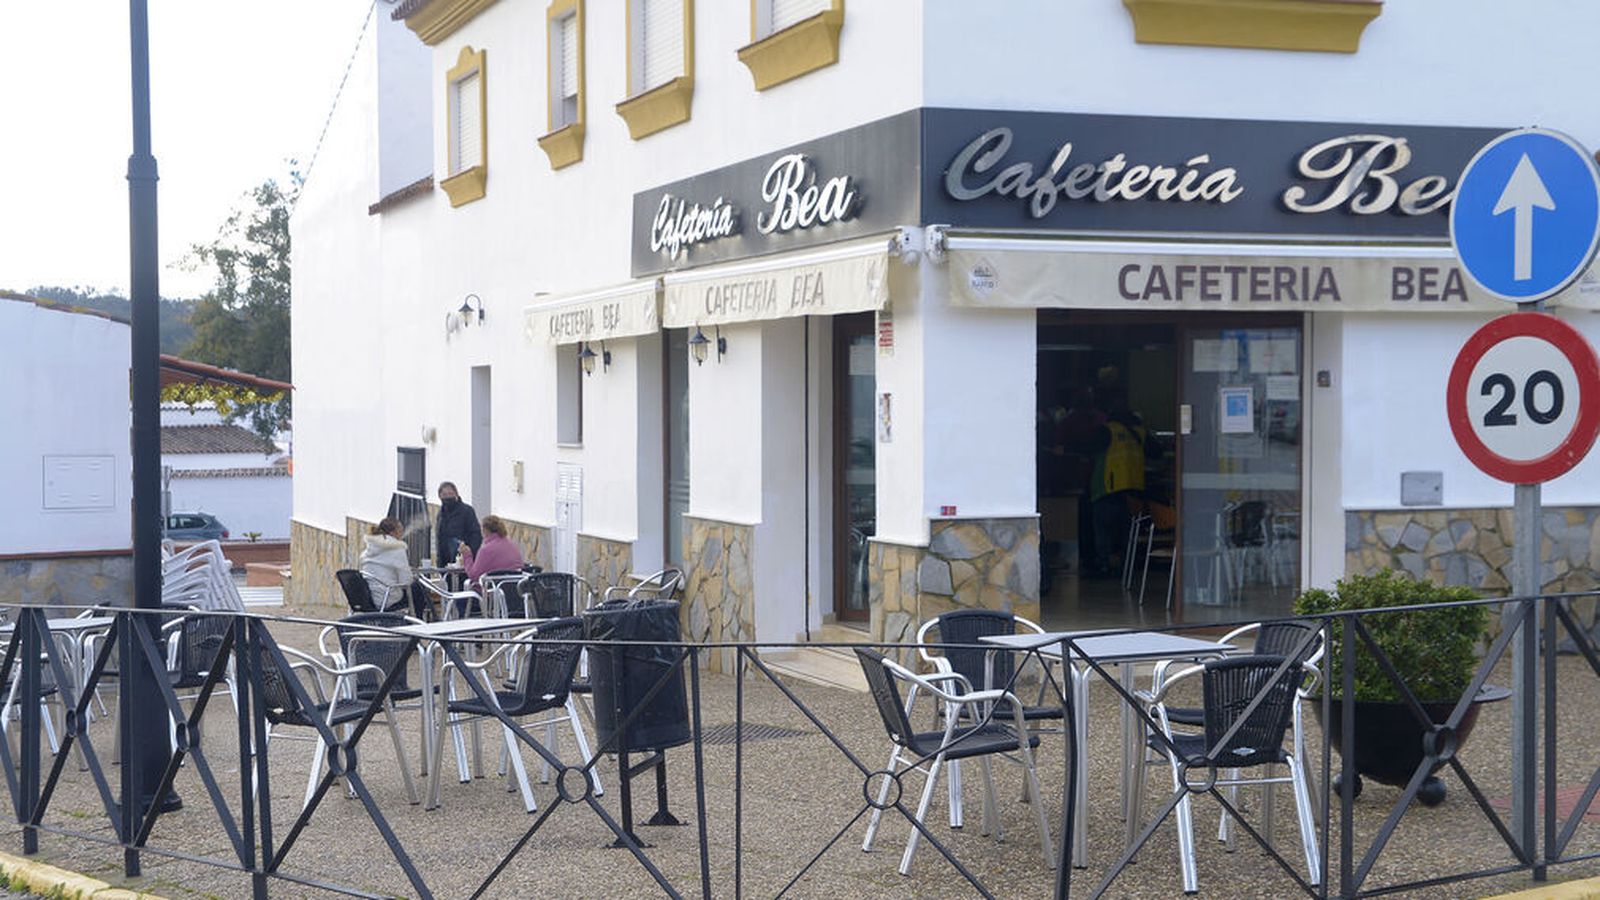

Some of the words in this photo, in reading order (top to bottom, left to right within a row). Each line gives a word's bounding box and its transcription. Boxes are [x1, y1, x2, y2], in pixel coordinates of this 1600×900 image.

[945, 127, 1243, 218] Cafetería
[1283, 134, 1455, 215] Be
[651, 193, 735, 257] Cafetería
[758, 153, 853, 234] Bea
[705, 278, 777, 316] CAFETERIA
[791, 271, 825, 307] BEA
[1118, 264, 1341, 302] CAFETERIA
[1391, 266, 1468, 302] BEA
[550, 308, 594, 338] CAFETERIA
[602, 303, 620, 330] BEA
[1480, 370, 1565, 426] 20
